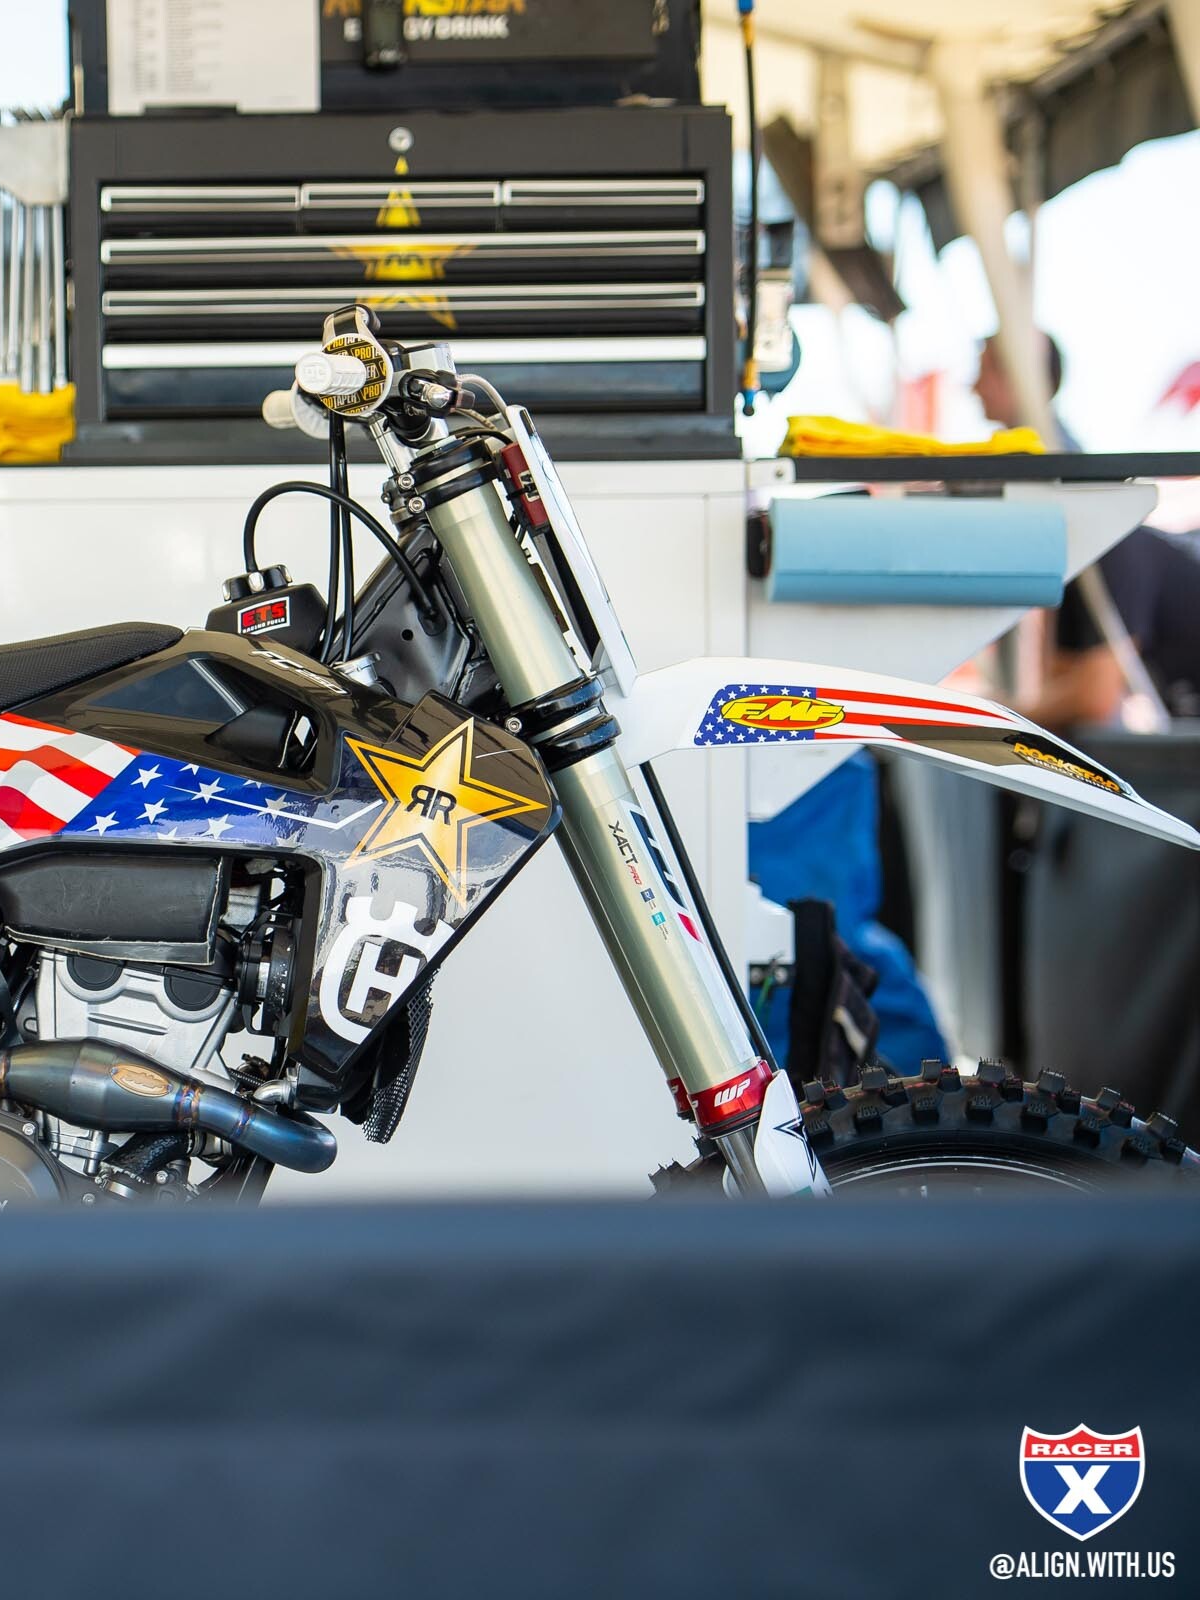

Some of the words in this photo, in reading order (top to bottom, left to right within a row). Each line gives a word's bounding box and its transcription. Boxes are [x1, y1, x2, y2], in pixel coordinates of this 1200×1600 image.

[343, 16, 434, 41] EGY
[435, 15, 509, 39] DRINK
[243, 602, 285, 627] ETS
[723, 700, 844, 722] FMF
[608, 820, 638, 865] XACT
[714, 1078, 751, 1108] WP
